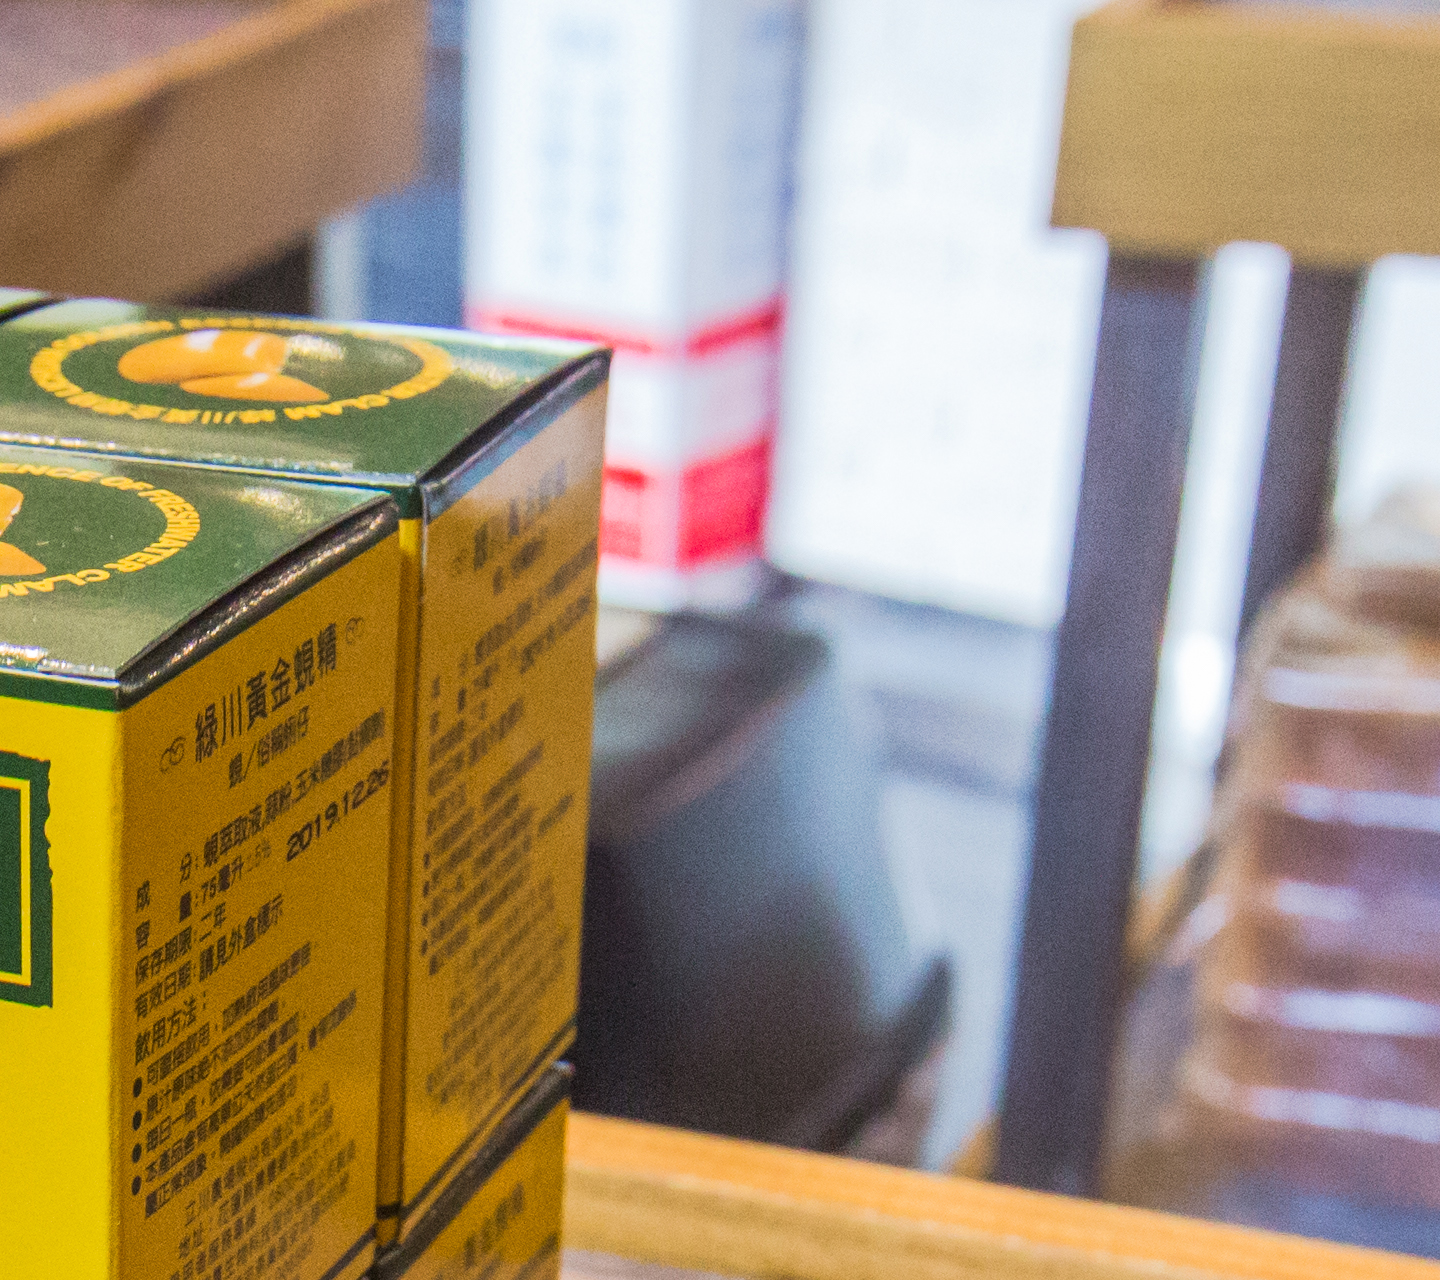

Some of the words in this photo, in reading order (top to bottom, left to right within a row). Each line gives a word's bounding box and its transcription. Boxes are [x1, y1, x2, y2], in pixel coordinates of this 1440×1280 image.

[100, 475, 153, 492] OF
[103, 487, 201, 574] FRESHWATER
[194, 617, 337, 770] 綠川黃金蜆精
